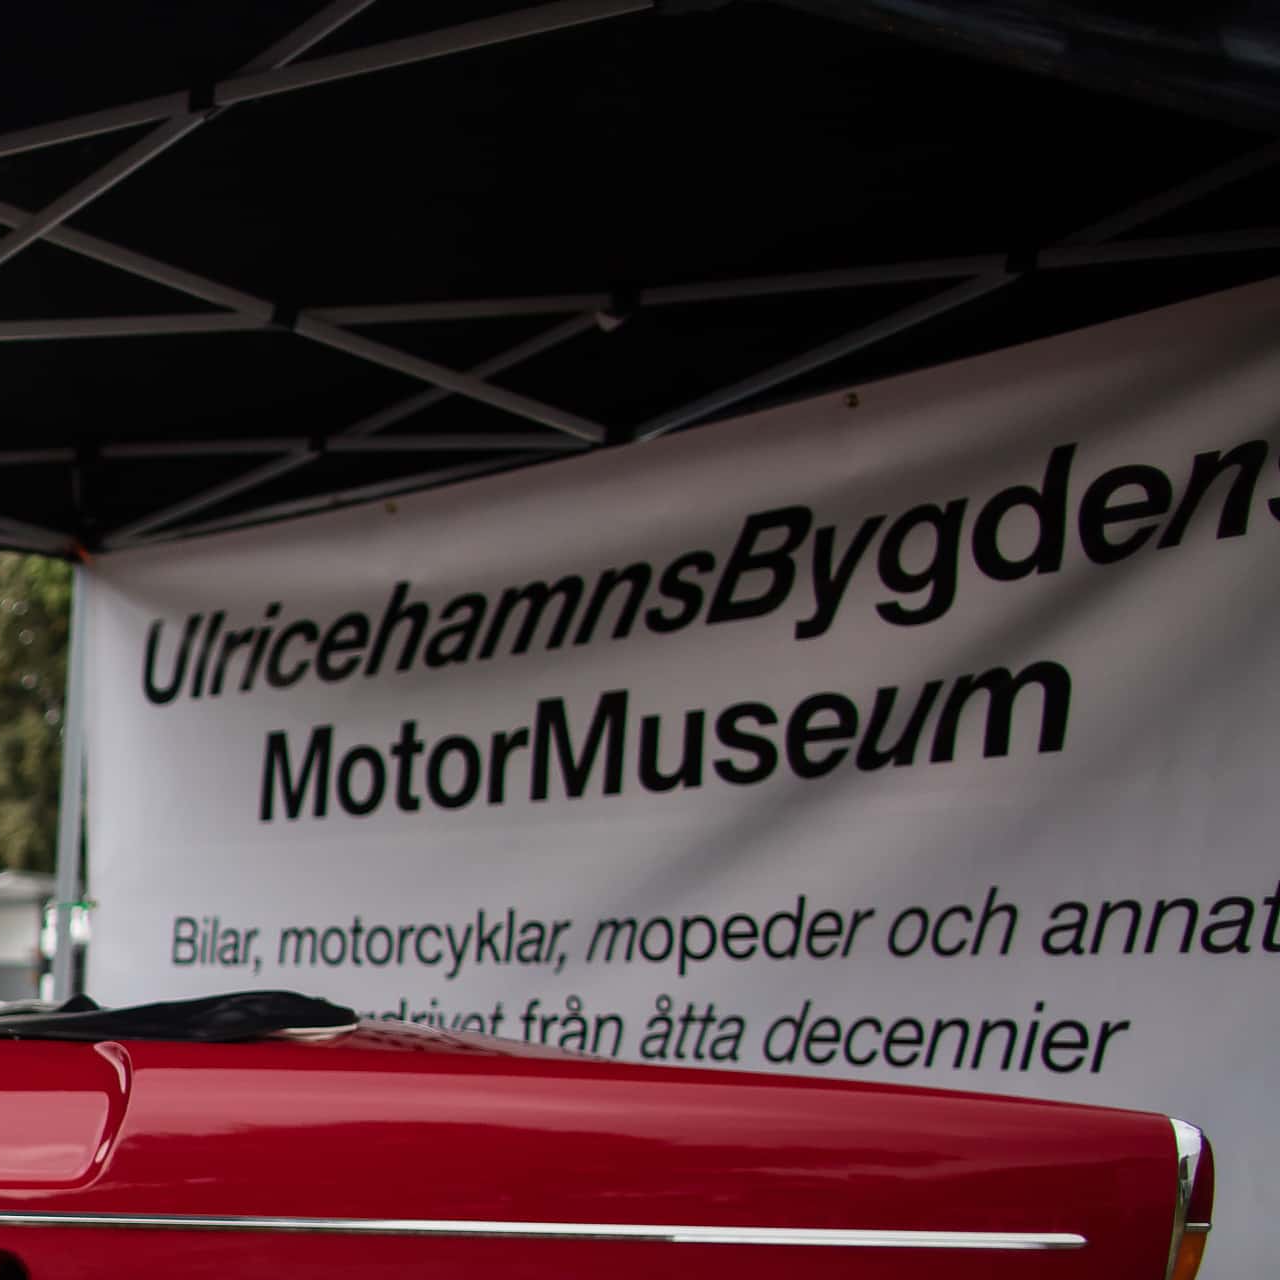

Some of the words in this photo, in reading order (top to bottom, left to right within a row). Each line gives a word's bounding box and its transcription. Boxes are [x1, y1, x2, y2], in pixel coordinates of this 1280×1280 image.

[143, 438, 1280, 706] UlricehamnsBygden
[259, 660, 1073, 823] MotorMuseum
[171, 916, 261, 975] Bilar,
[277, 908, 571, 979] motorcyklar,
[586, 894, 875, 976] mopeder
[887, 886, 1019, 959] och
[520, 994, 623, 1057] från
[640, 993, 746, 1062] åtta
[763, 1000, 1132, 1074] decennier
